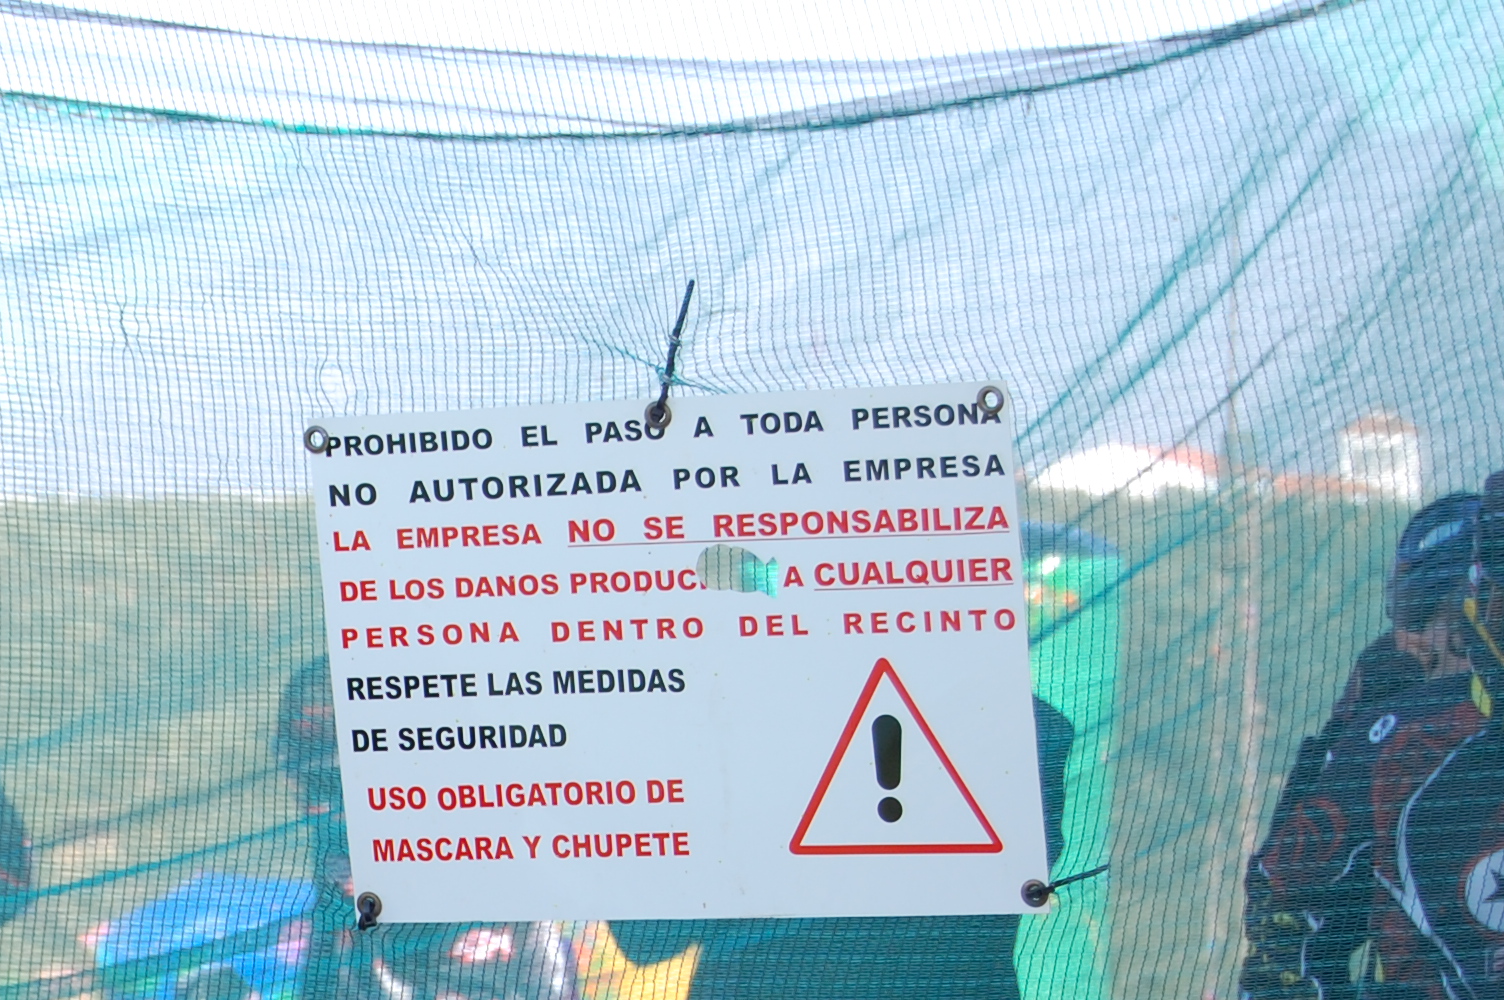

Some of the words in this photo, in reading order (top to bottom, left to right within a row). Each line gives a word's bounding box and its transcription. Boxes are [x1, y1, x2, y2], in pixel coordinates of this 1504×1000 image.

[326, 428, 493, 457] PROHIBIDO
[521, 426, 558, 447] EL
[585, 420, 666, 444] PASO
[694, 416, 714, 438] A
[740, 410, 824, 435] TODA
[329, 483, 377, 507] NO
[409, 469, 642, 504] AUTORIZADA
[673, 466, 741, 490] POR
[771, 463, 812, 485] LA
[843, 454, 1005, 482] EMPRESA
[333, 531, 372, 552] LA
[397, 523, 542, 549] EMPRESA
[568, 518, 615, 543] NO
[643, 516, 685, 540] SE
[713, 506, 1009, 538] RESPONSABILIZA
[340, 580, 378, 602] DE
[389, 578, 445, 600] LOS
[455, 574, 559, 598] DANOS
[570, 569, 707, 595] PRODUC
[783, 566, 804, 588] A
[814, 558, 1013, 587] CUALQUIER
[341, 622, 520, 649] PERSONA
[551, 617, 705, 643] DENTRO
[739, 615, 809, 637] DEL
[843, 609, 1016, 635] RECINTO
[347, 673, 478, 700] RESPETE
[487, 671, 543, 697] LAS
[553, 668, 686, 694] MEDIDAS
[352, 729, 388, 752] DE
[398, 724, 567, 751] SEGURIDAD
[368, 786, 427, 811] USO
[438, 779, 636, 811] OBLIGATORIO
[646, 779, 685, 804] DE
[373, 836, 514, 862] MASCARA
[522, 835, 542, 859] Y
[552, 832, 690, 859] CHUPETE
